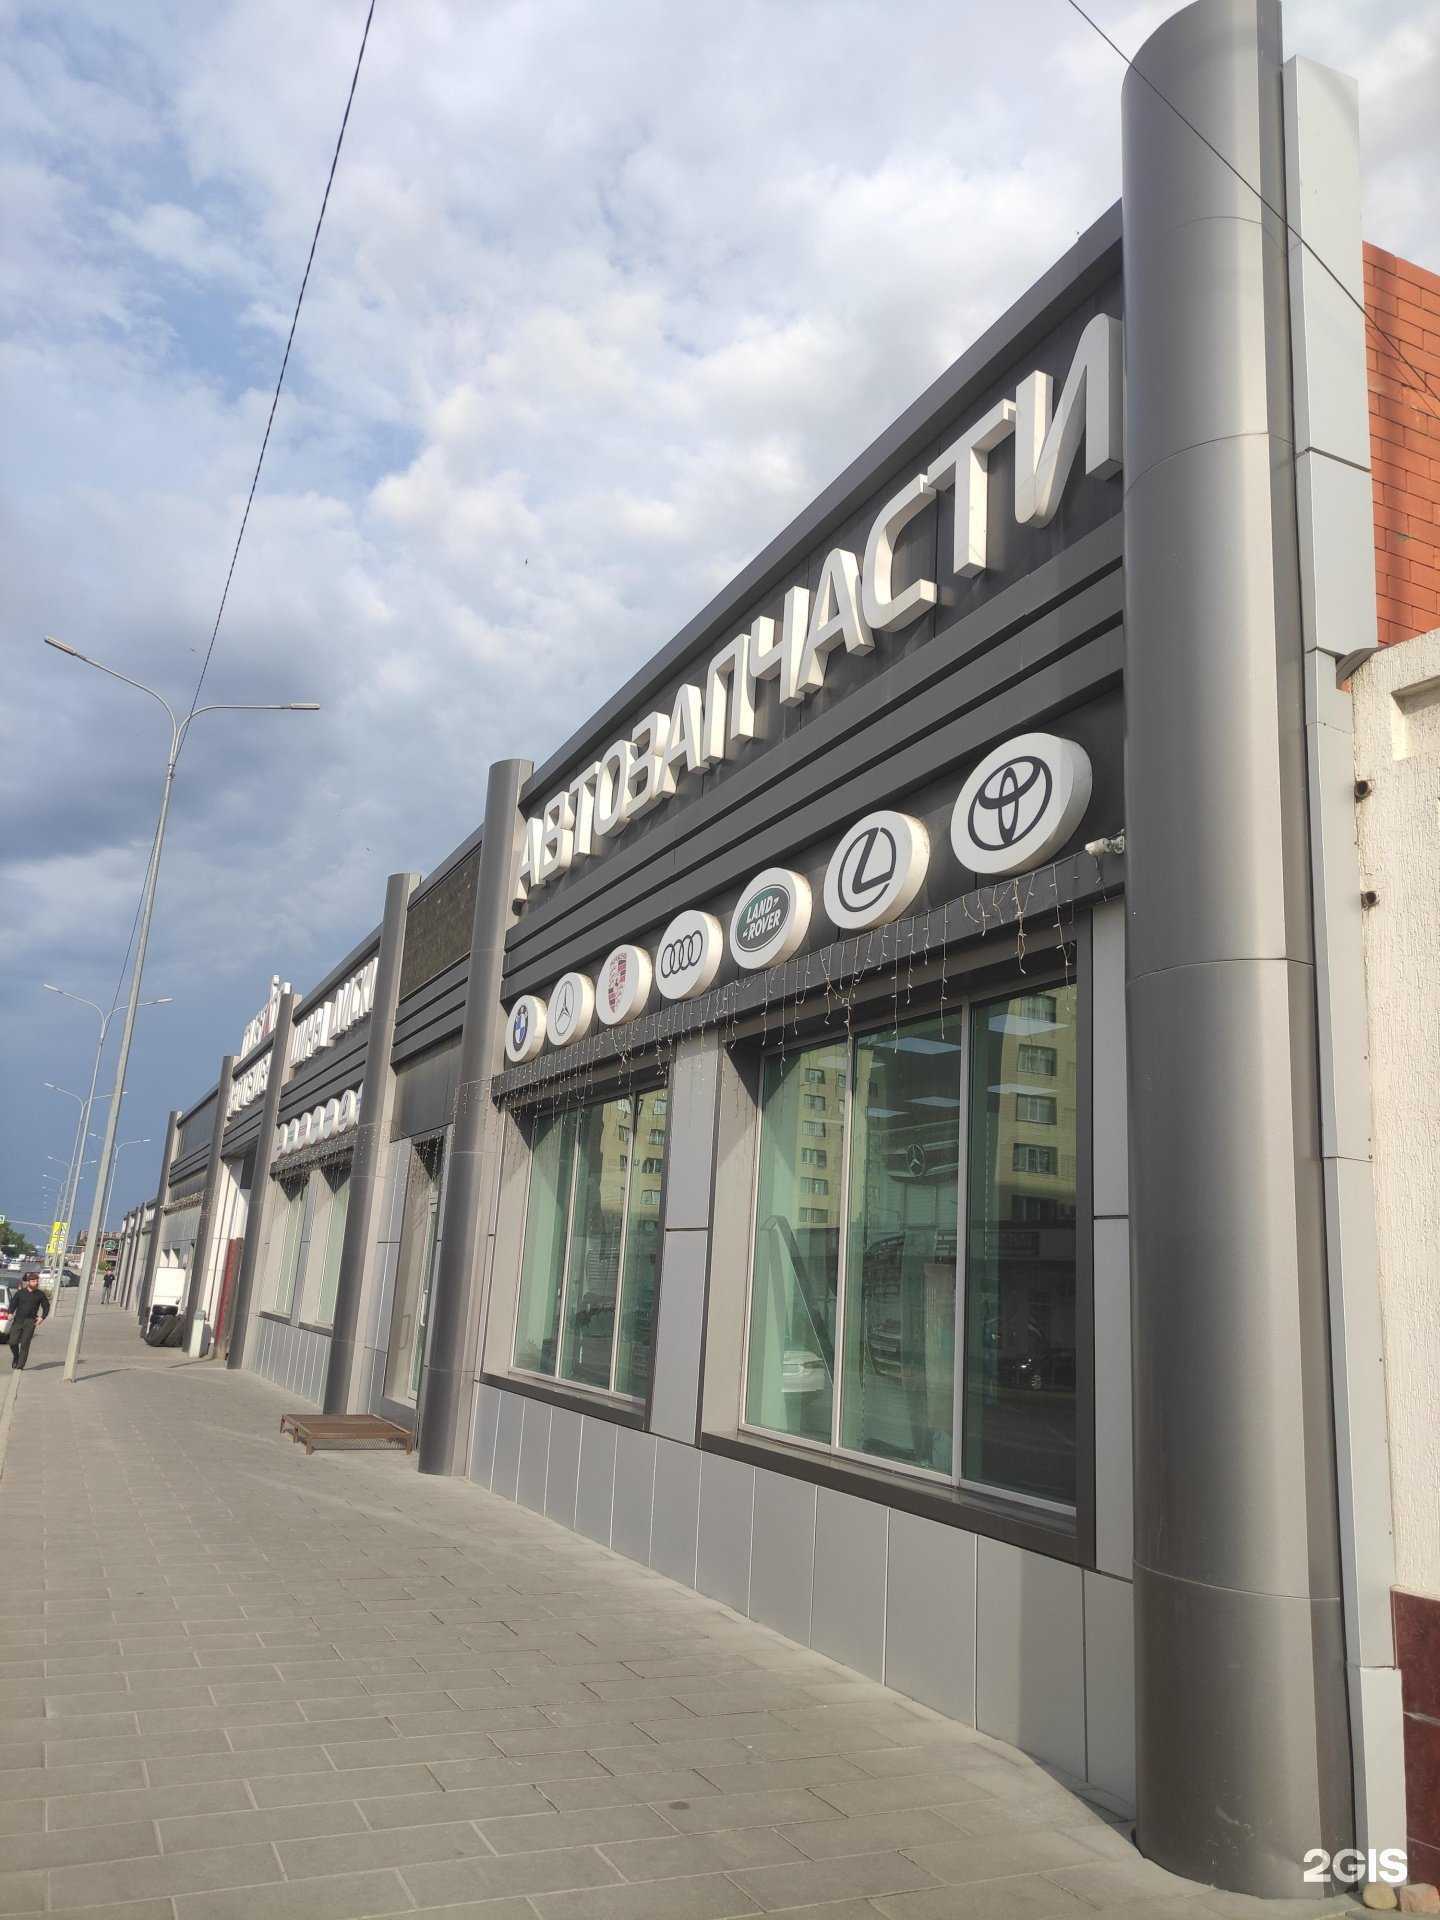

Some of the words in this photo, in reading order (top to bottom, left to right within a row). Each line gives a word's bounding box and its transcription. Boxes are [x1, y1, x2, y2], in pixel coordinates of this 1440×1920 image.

[513, 313, 1123, 902] АВТОЗАПЧАСТИ
[746, 895, 775, 924] LAND
[747, 908, 781, 941] ROVER
